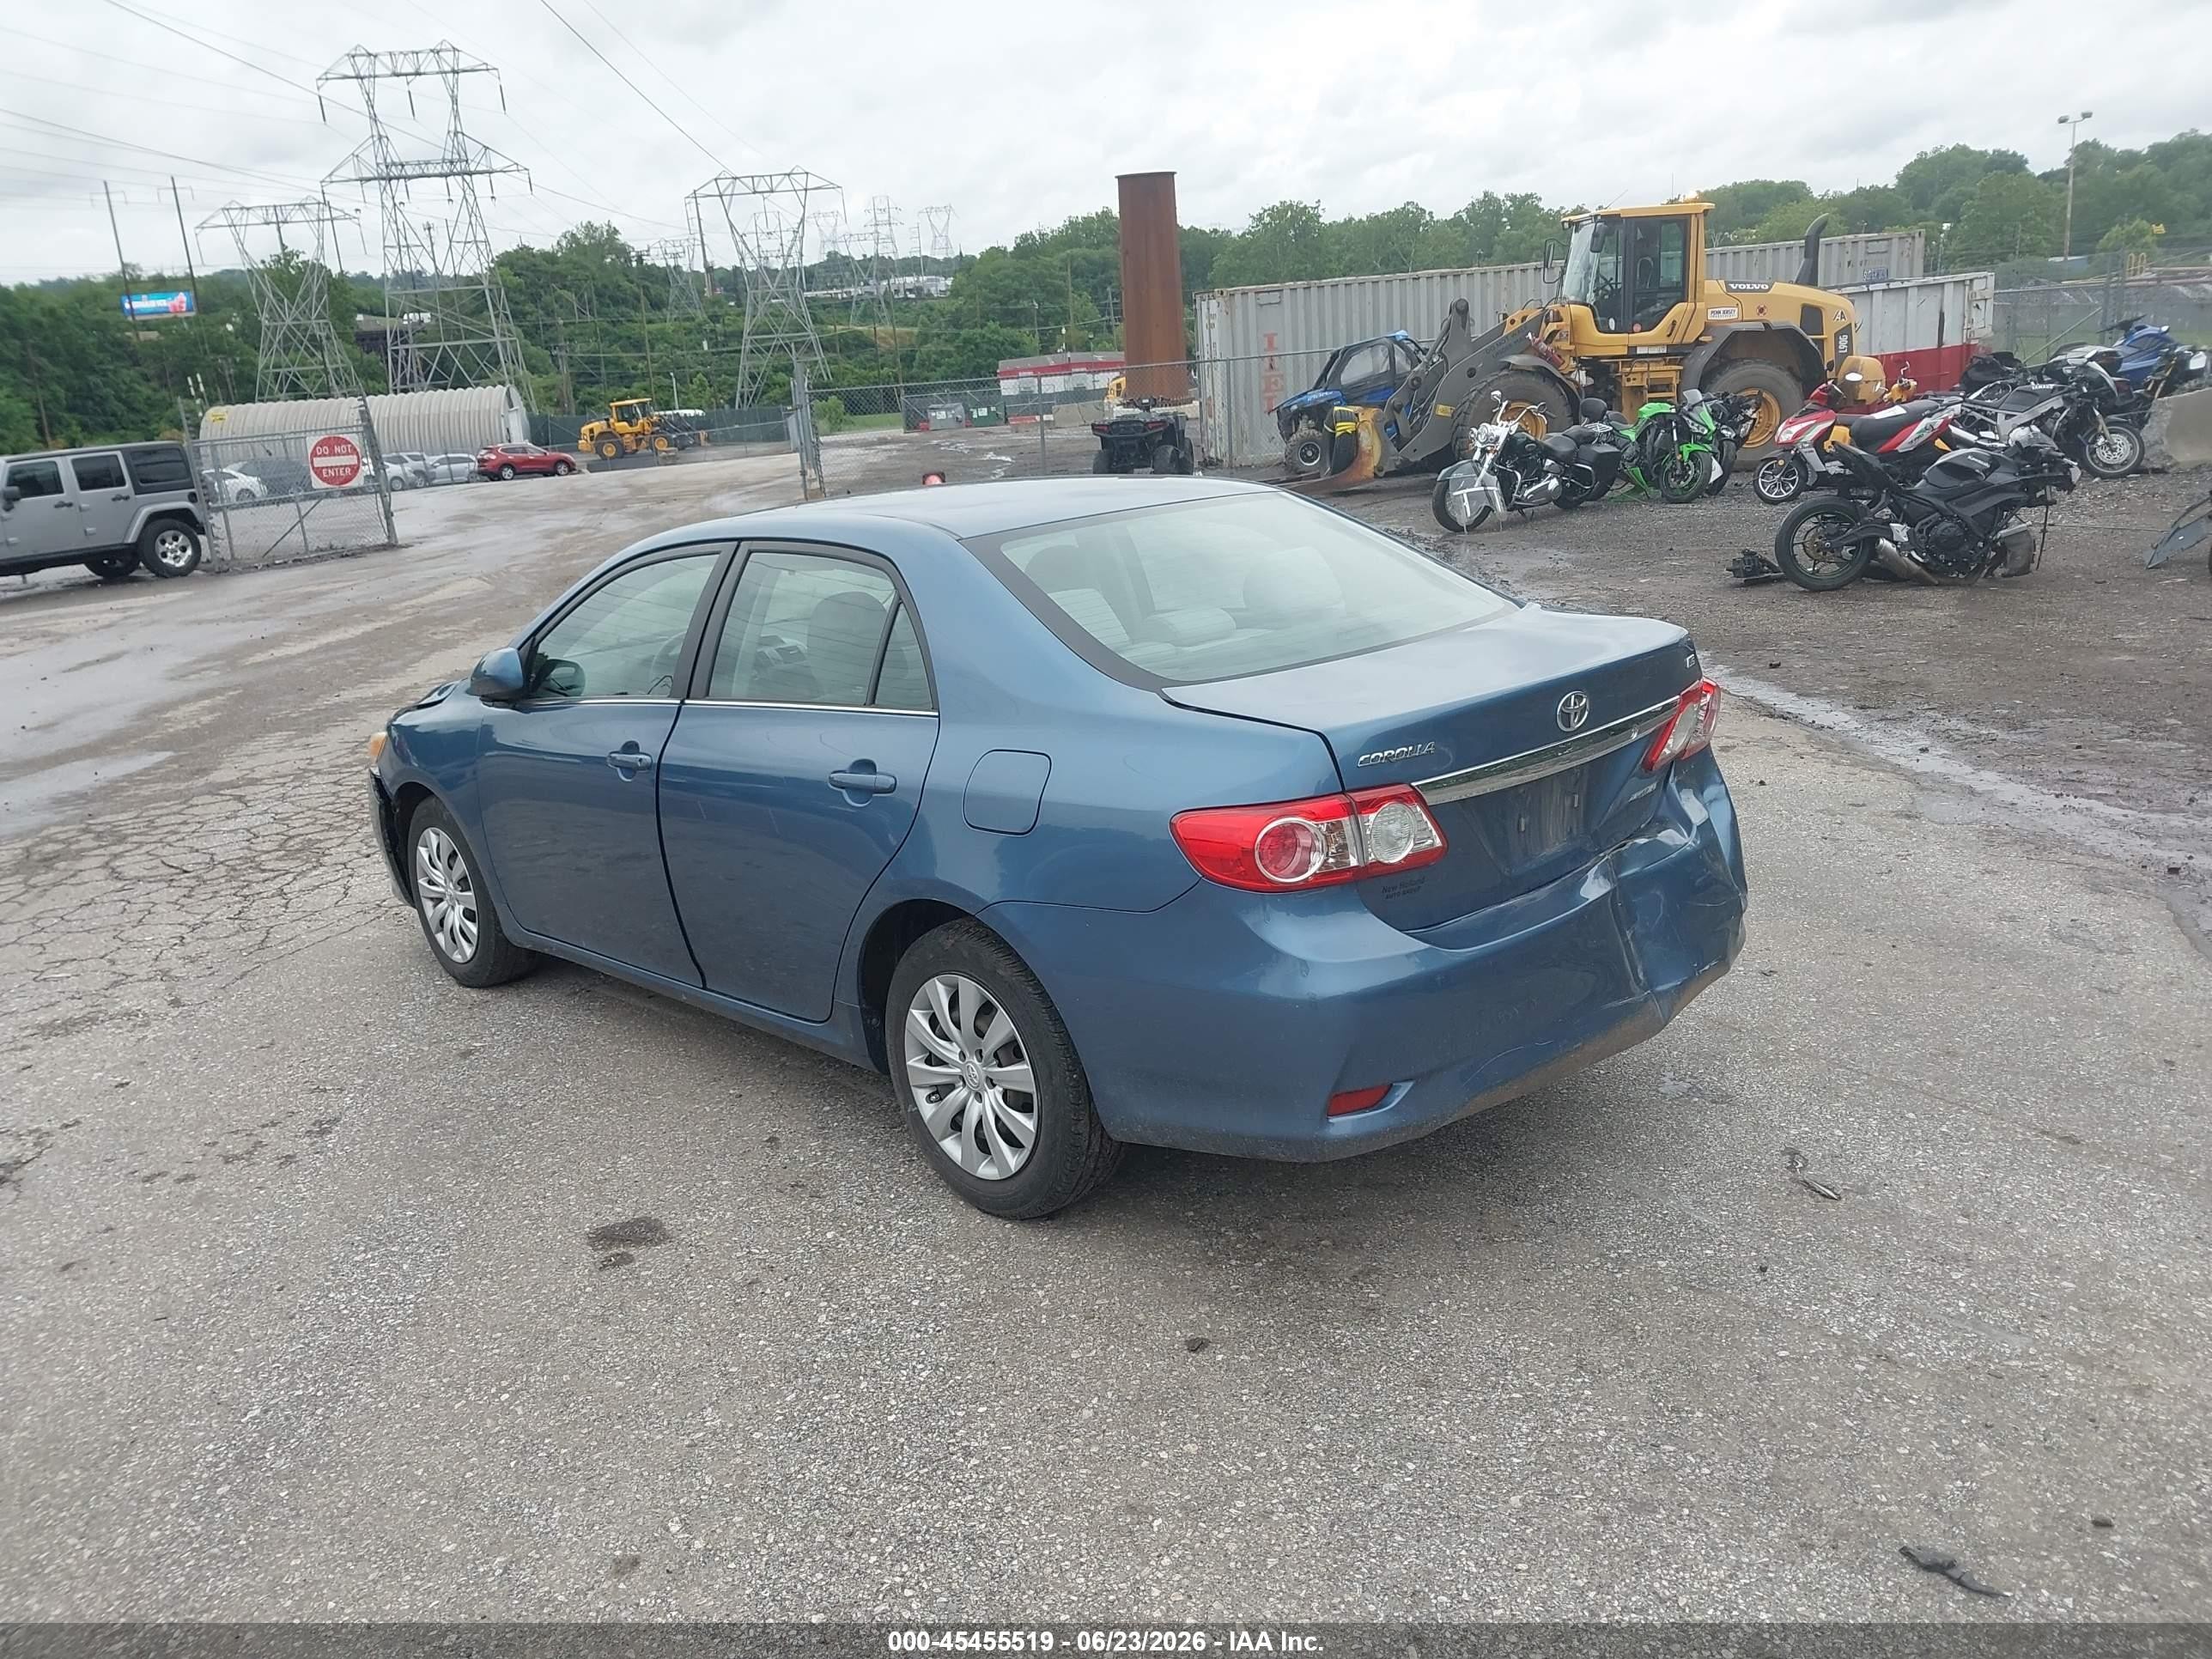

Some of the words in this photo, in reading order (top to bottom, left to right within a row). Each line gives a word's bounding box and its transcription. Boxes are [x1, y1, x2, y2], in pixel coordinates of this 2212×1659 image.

[1838, 334, 1849, 354] L90G
[316, 446, 329, 455] DO
[335, 444, 352, 454] NOT
[322, 467, 351, 477] ENTER
[1358, 741, 1435, 767] COROLLA
